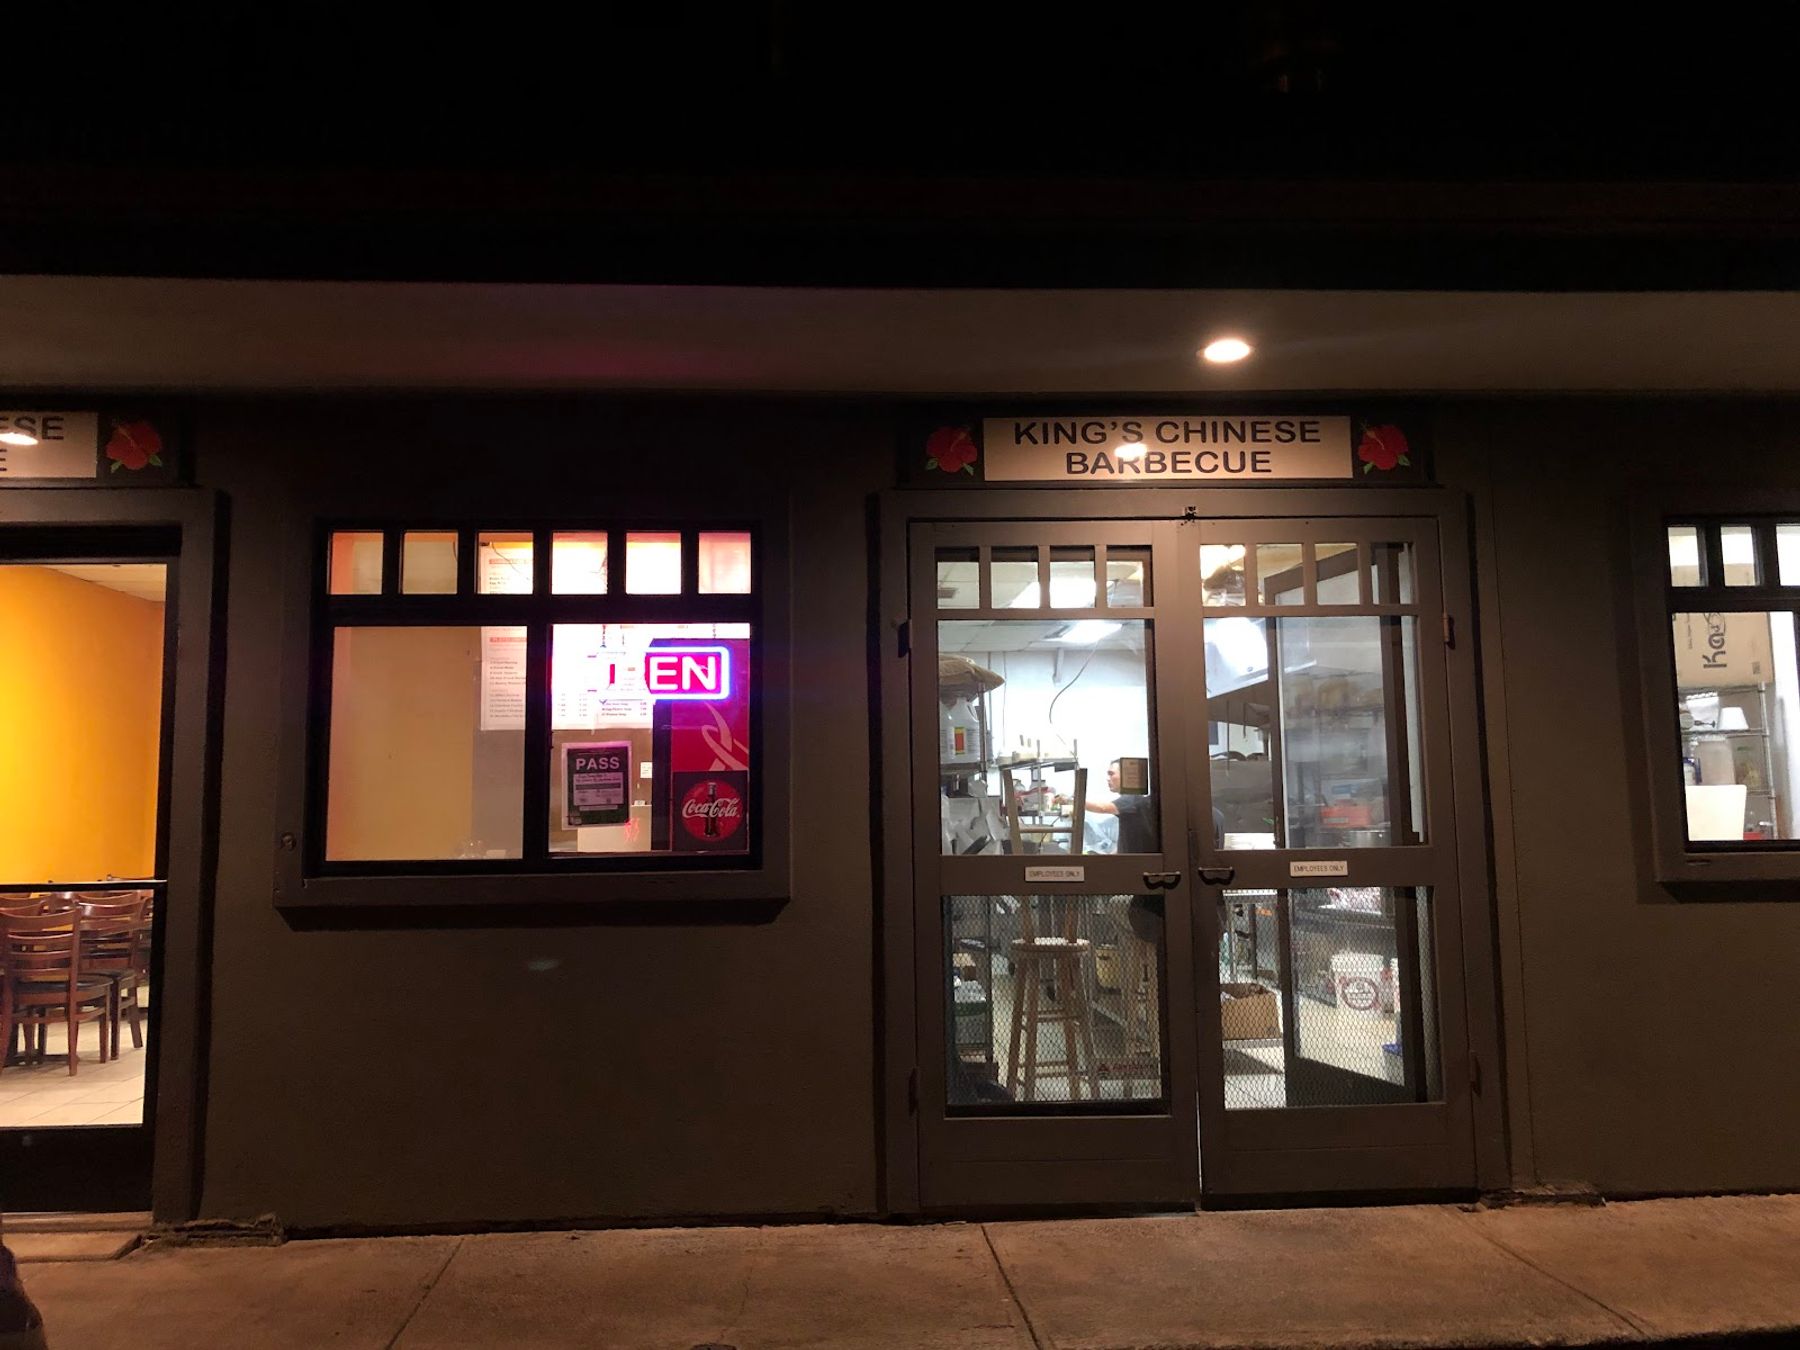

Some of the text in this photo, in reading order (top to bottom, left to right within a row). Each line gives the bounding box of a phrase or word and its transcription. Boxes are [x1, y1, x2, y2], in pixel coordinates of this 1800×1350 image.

[1014, 421, 1321, 445] KING'S CHINESE
[1066, 451, 1272, 474] BARBECUE
[576, 757, 620, 770] PASS
